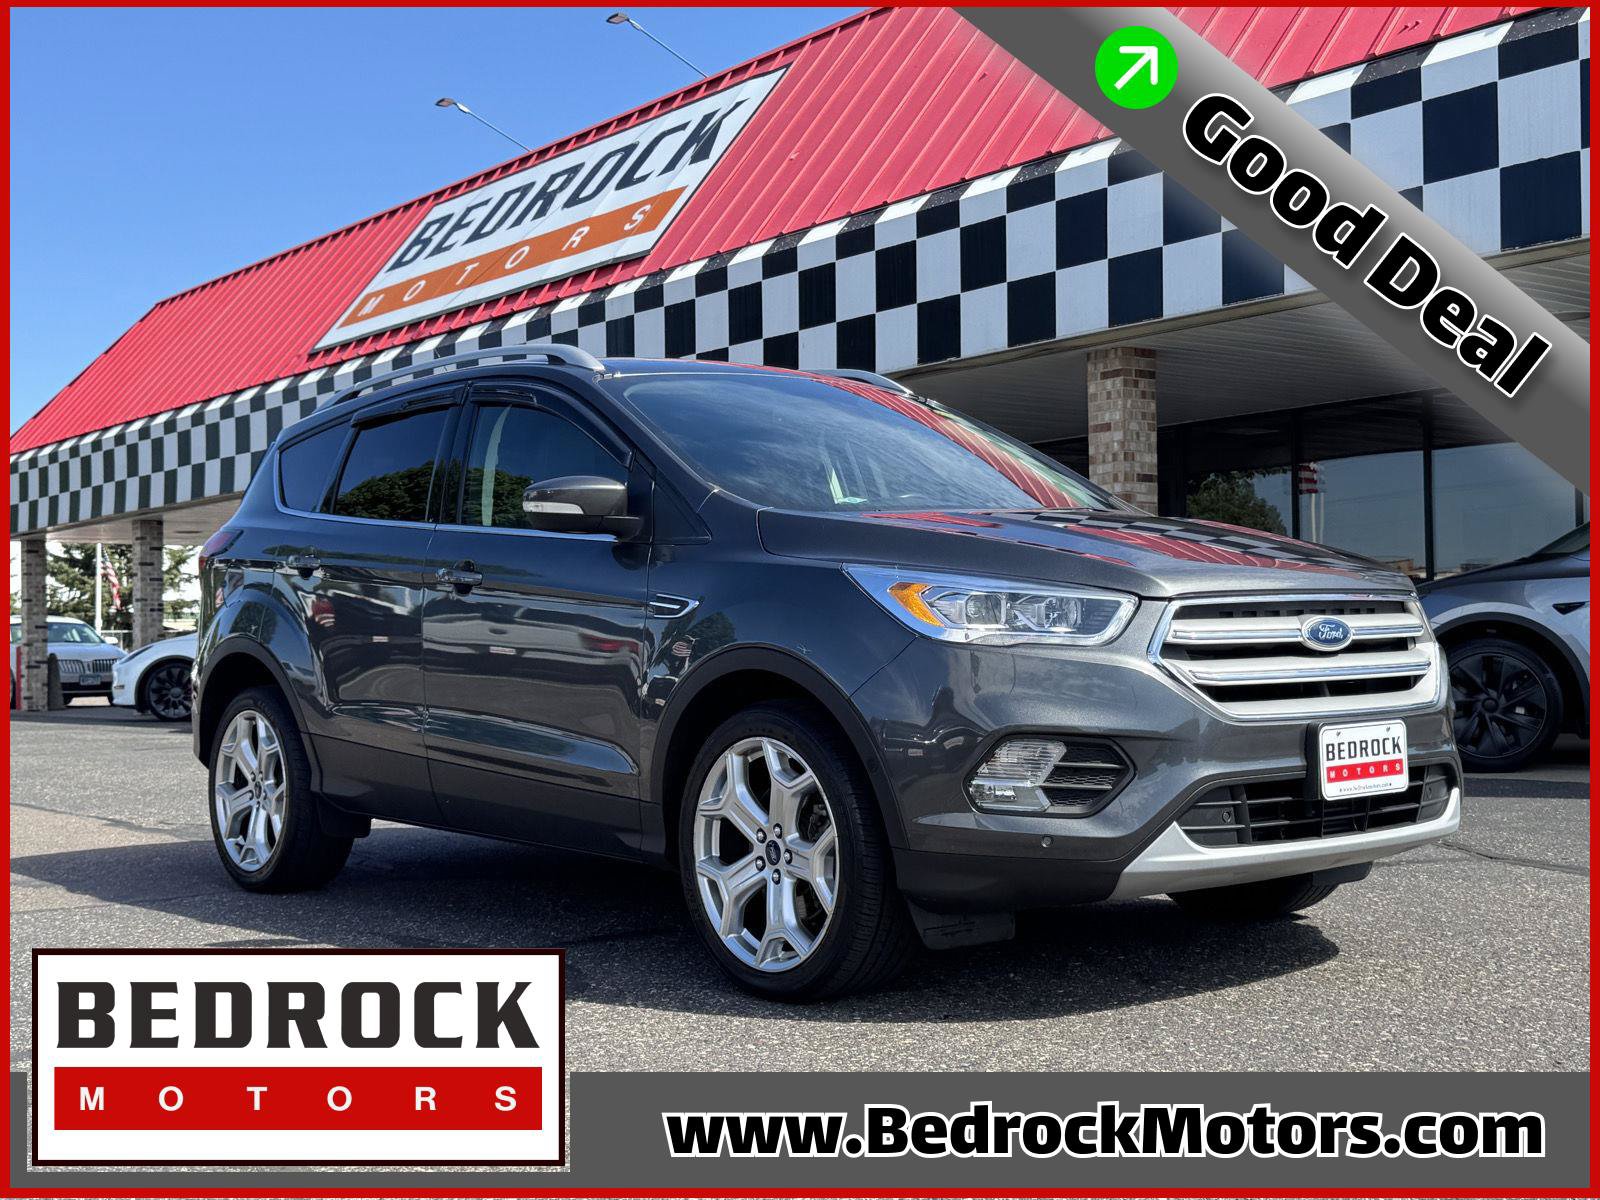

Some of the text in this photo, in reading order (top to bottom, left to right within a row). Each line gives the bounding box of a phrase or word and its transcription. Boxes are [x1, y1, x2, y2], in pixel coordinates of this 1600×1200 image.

[387, 98, 750, 273] BEDROCK
[358, 204, 651, 318] MOTORS
[1318, 623, 1344, 640] Ford
[1326, 736, 1402, 762] BEDROCK
[1329, 763, 1401, 779] MOTORS
